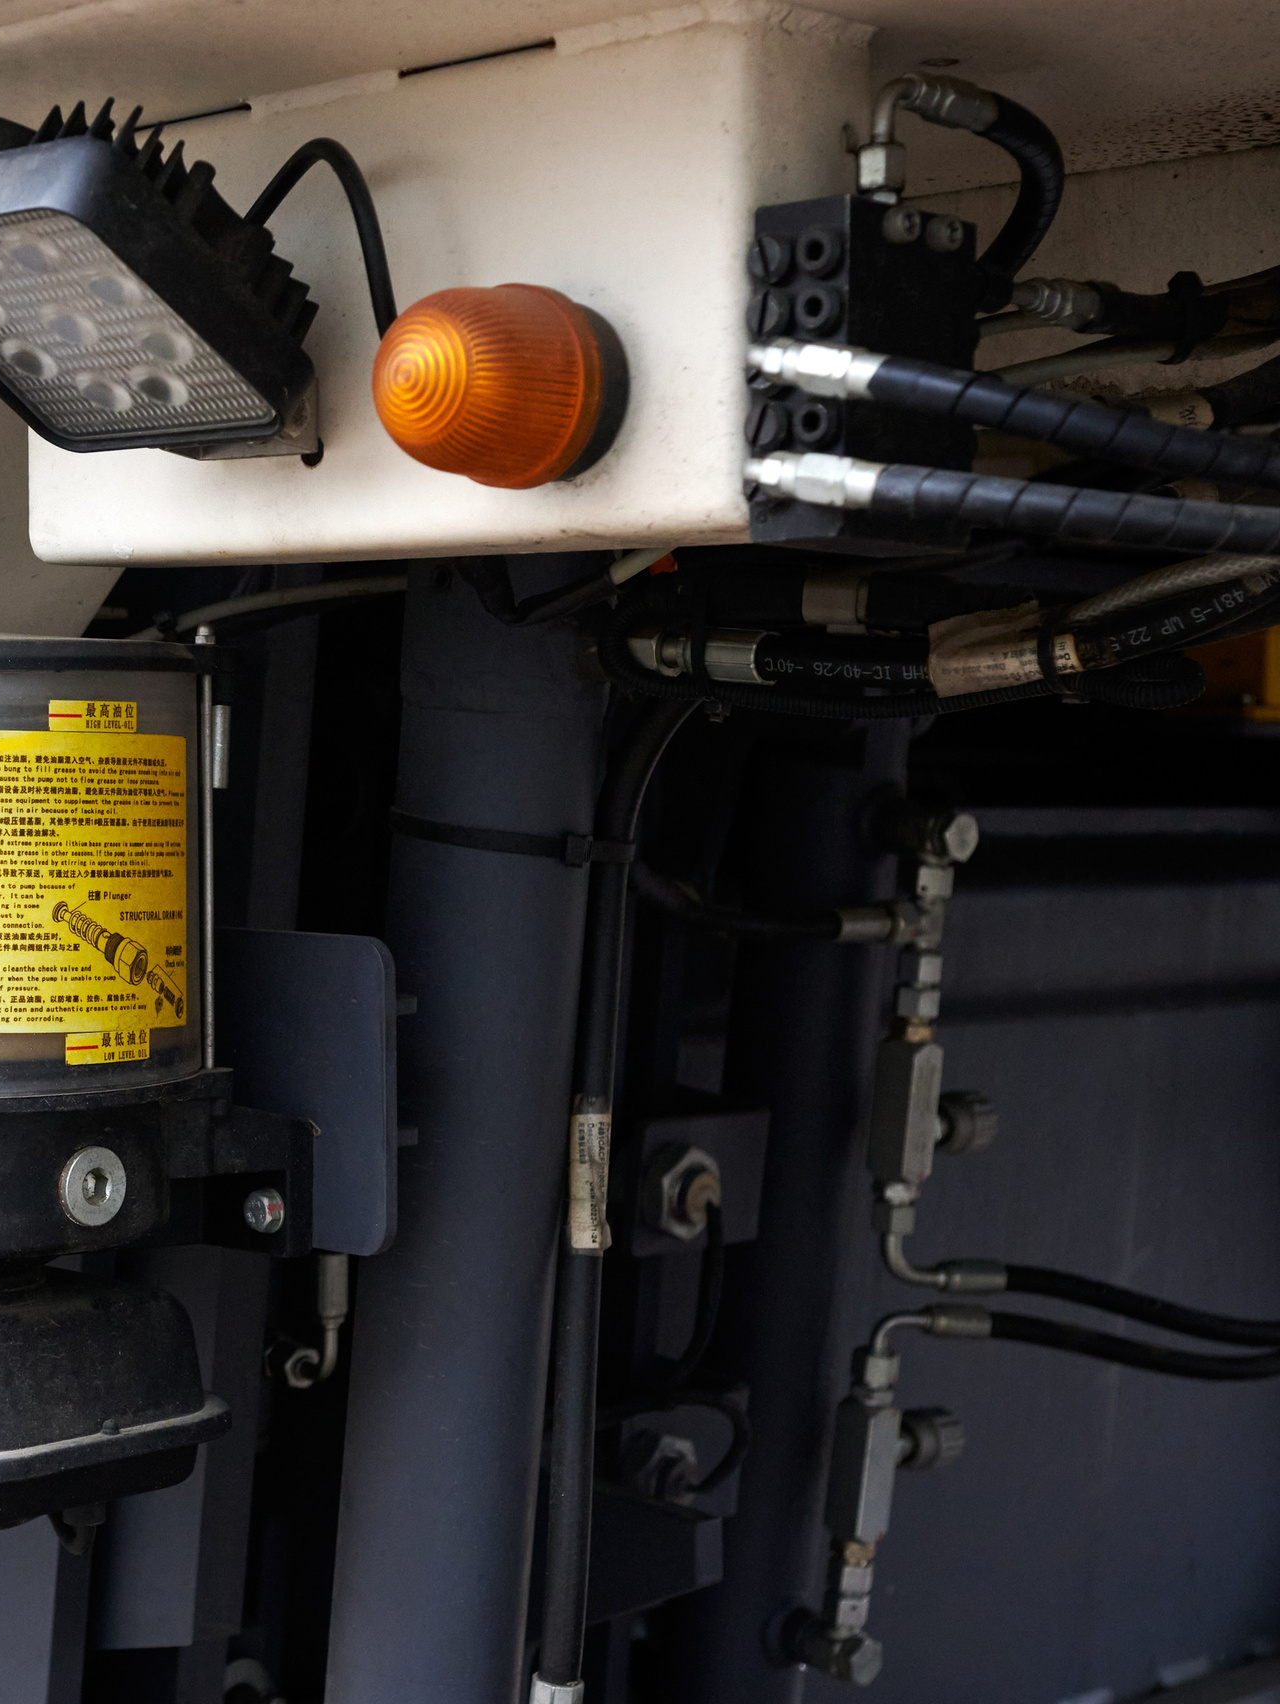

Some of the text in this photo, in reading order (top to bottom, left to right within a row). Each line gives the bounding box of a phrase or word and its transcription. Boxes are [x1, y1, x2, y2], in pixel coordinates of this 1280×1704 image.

[1161, 615, 1185, 635] WP
[813, 661, 891, 680] IC-40/26
[85, 702, 134, 719] 最高油位
[85, 720, 134, 730] HIGH LEVEL-OIL
[4, 766, 21, 774] bung
[16, 797, 50, 805] equipment
[64, 798, 98, 806] supplement
[81, 808, 104, 816] lacking
[51, 859, 58, 867] by
[61, 859, 87, 867] stirring
[103, 891, 132, 901] Plunger
[16, 912, 24, 920] by
[119, 911, 162, 921] STRUCTURAL
[101, 1030, 147, 1048] 最低油位
[104, 1049, 147, 1061] LOW LEVEL OIL
